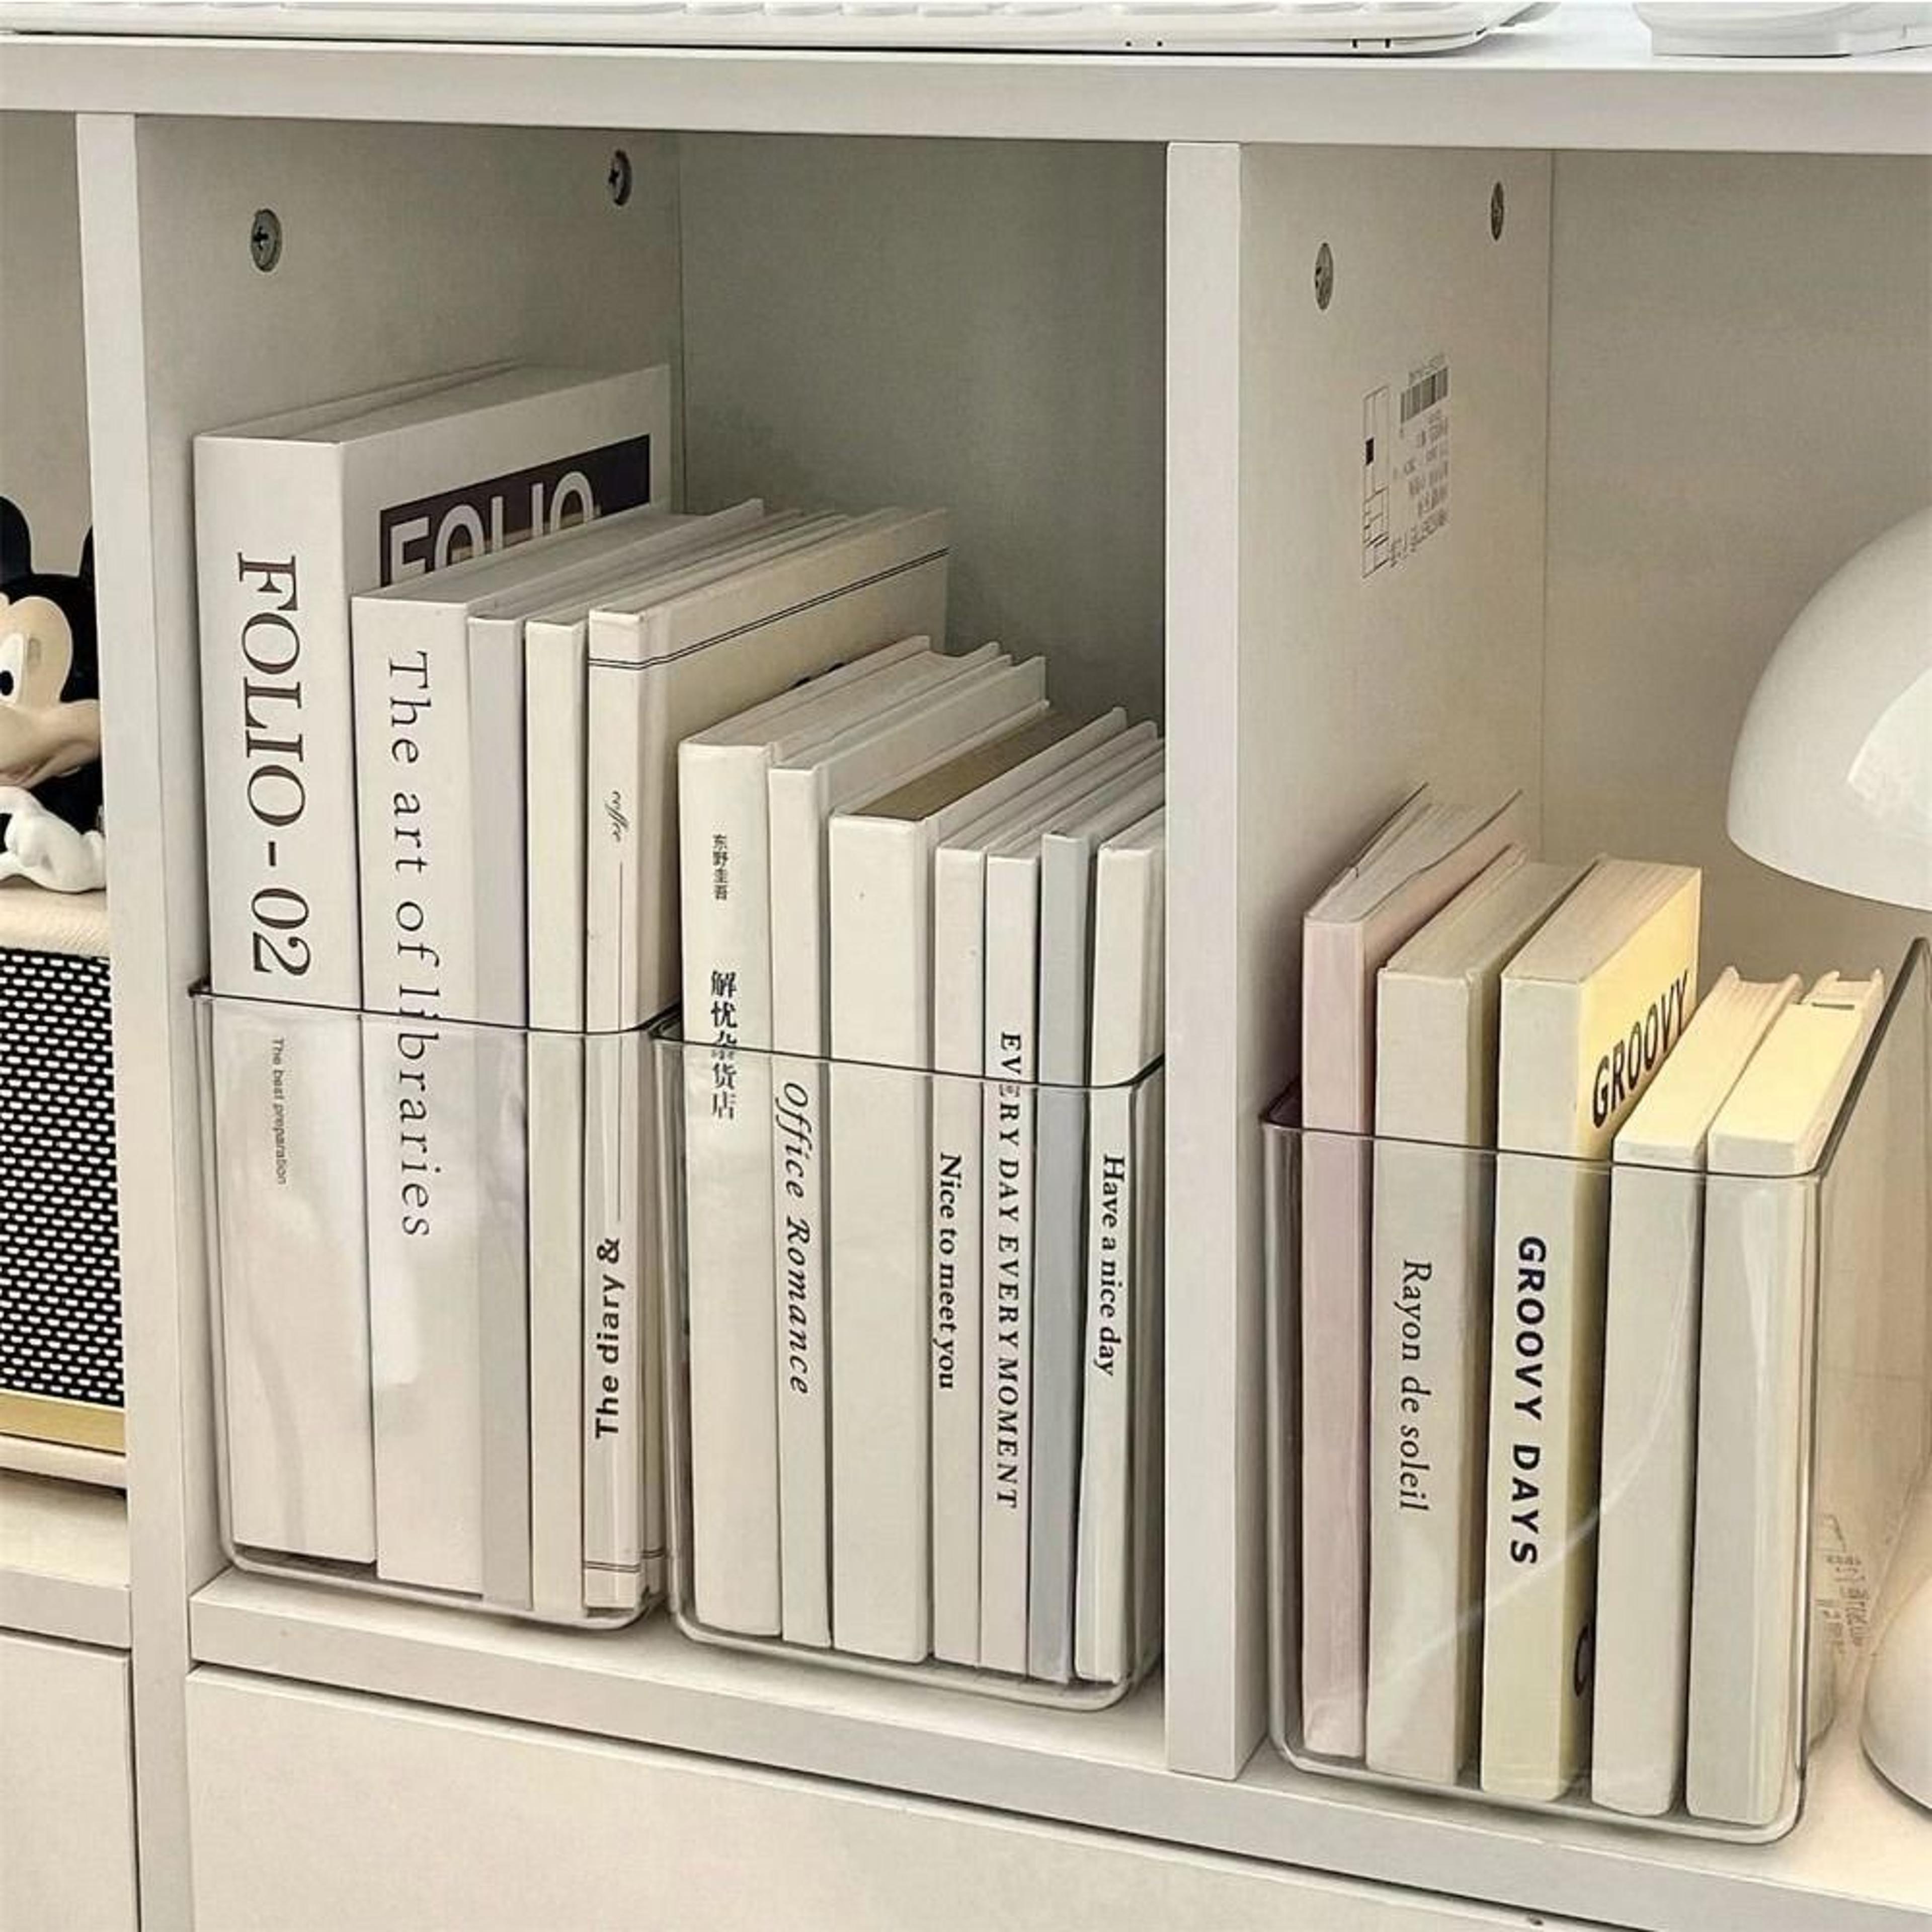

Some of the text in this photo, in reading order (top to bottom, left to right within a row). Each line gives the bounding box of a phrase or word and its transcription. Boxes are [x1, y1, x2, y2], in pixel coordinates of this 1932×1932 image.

[237, 552, 305, 827] FOLIO
[252, 889, 310, 976] 02
[272, 1038, 285, 1065] The
[390, 651, 440, 1235] The art of libraries
[1593, 969, 1688, 1129] GROOVY
[596, 1239, 625, 1438] The diary &
[775, 1083, 812, 1394] Office Romance
[933, 1153, 961, 1390] Nice to meet you
[997, 1032, 1021, 1508] EVERY DAY EVERY MOMENT
[1094, 1155, 1124, 1376] Have a nice day
[1394, 1260, 1431, 1510] Rayon de soleil
[1511, 1237, 1546, 1563] GROOVY DAYS
